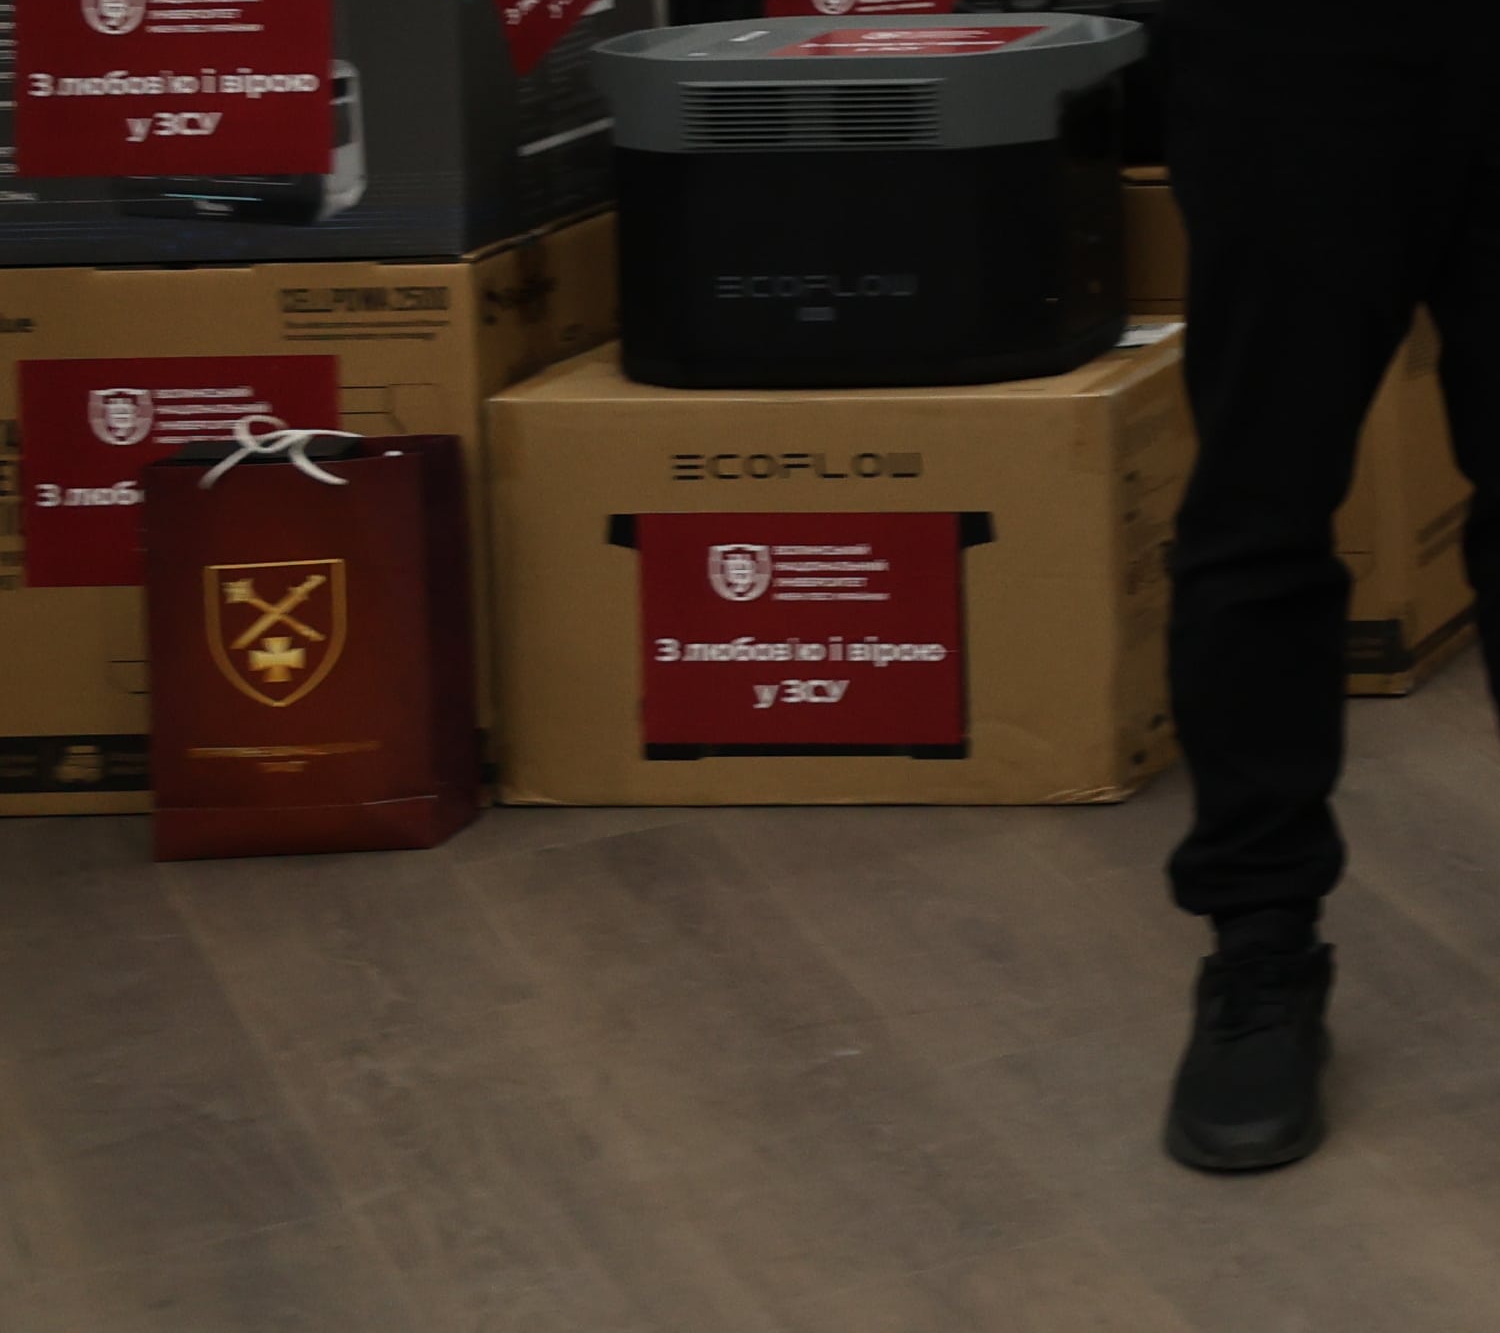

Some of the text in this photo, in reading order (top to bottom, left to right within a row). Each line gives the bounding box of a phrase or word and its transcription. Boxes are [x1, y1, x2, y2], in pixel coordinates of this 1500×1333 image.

[27, 73, 53, 96] З
[201, 67, 218, 93] і
[219, 67, 320, 99] вірою
[125, 112, 223, 143] у ЗСУ
[714, 274, 918, 299] ECOFLOW
[671, 451, 925, 481] ECOFLOW
[34, 483, 62, 507] З
[654, 638, 681, 662] З
[828, 636, 843, 661] і
[846, 636, 947, 668] вірою
[752, 679, 850, 709] у ЗСУ
